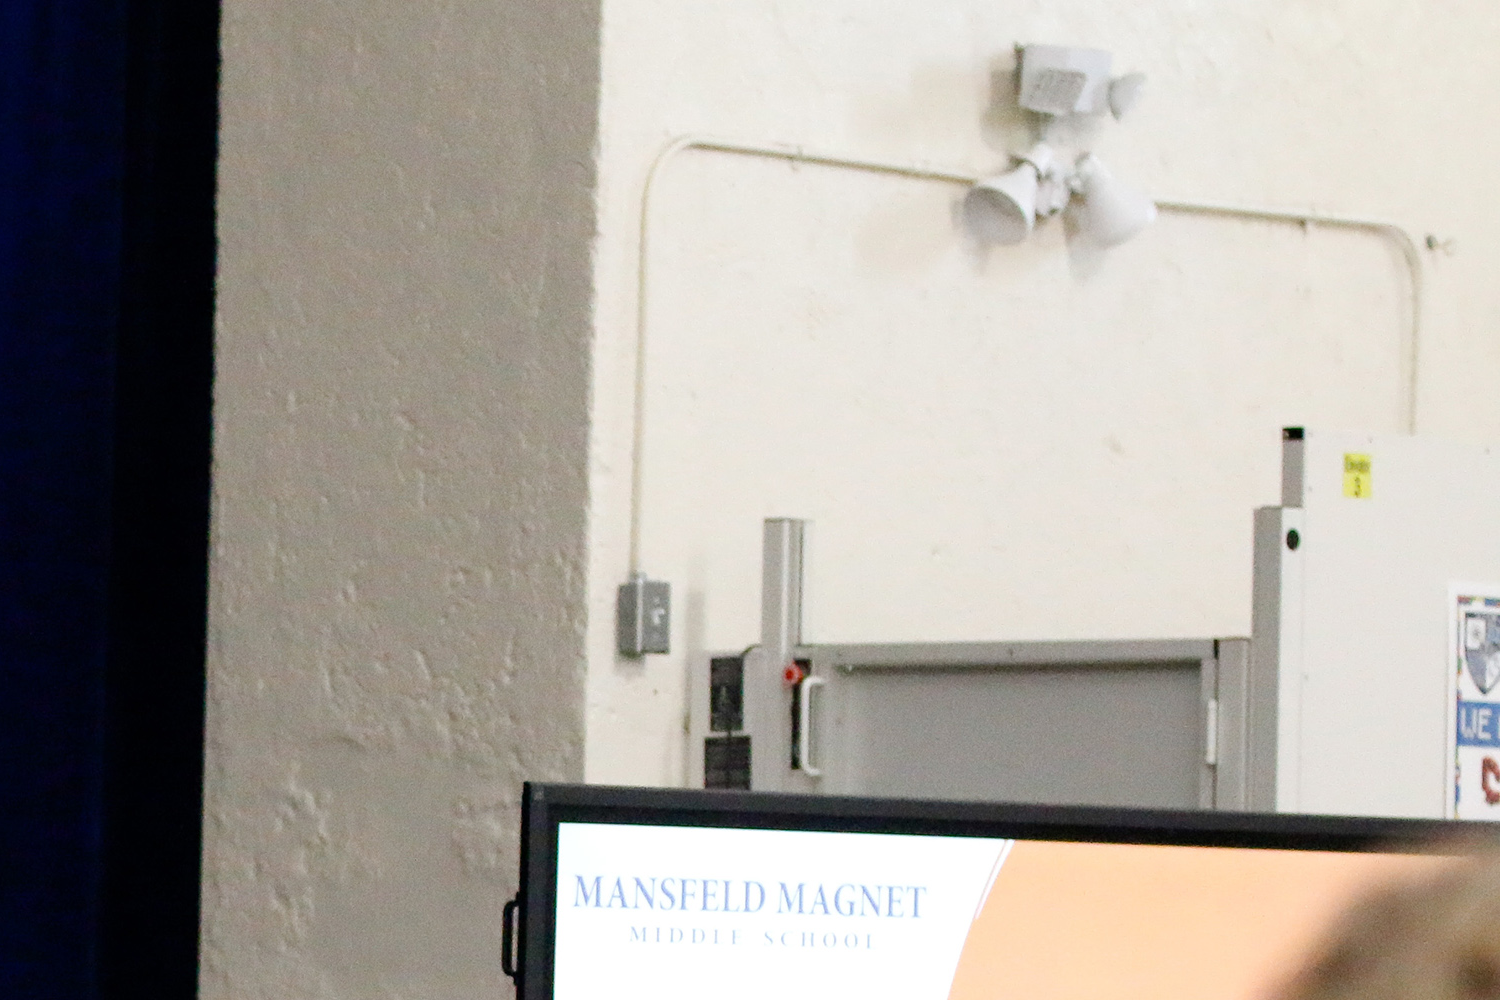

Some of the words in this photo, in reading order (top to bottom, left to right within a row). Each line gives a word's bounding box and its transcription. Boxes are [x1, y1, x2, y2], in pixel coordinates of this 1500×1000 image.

[1460, 707, 1492, 740] WE
[573, 874, 767, 914] MANSFELD
[776, 881, 928, 919] MAGNET
[629, 926, 743, 946] MIDDLE
[763, 930, 873, 950] SCHOOL
